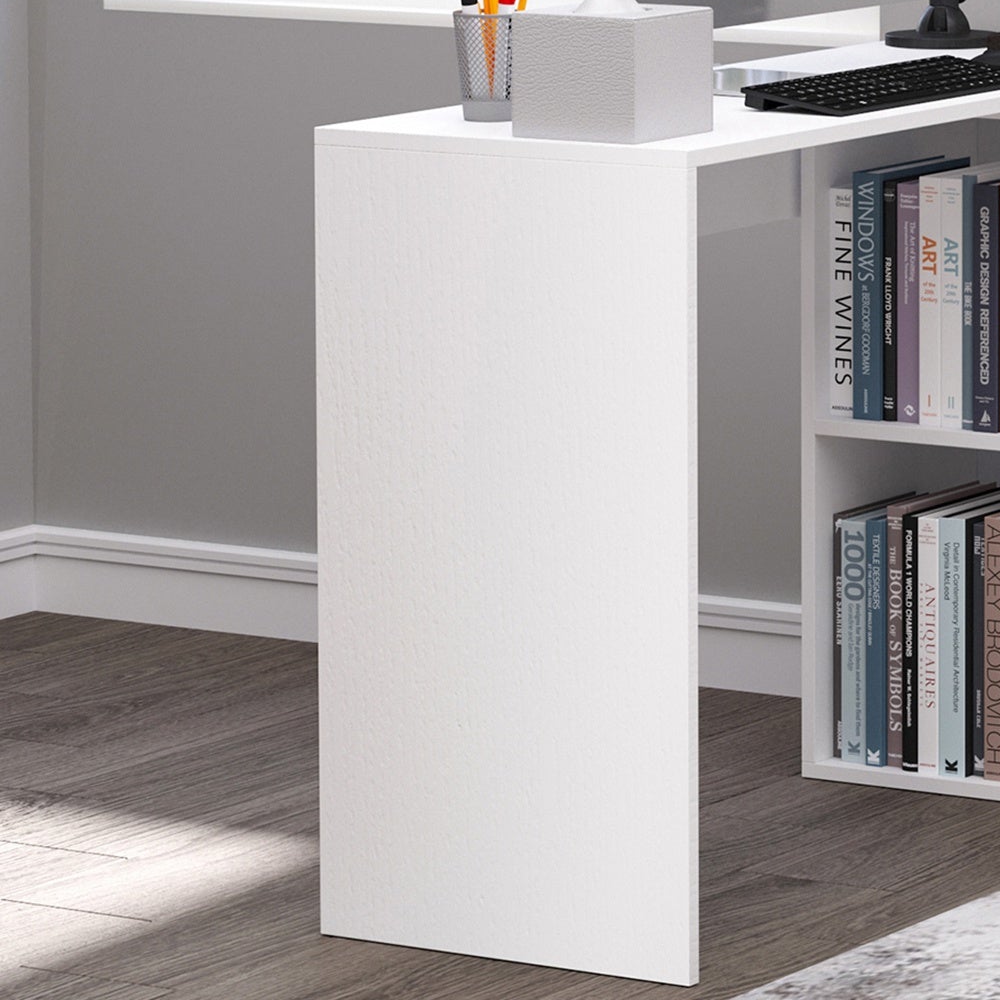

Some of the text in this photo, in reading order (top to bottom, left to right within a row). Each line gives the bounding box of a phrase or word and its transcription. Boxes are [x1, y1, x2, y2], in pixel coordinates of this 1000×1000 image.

[835, 221, 852, 281] FINE
[857, 181, 874, 281] WINDOWS
[922, 236, 936, 275] ART
[944, 237, 958, 276] ART
[980, 206, 990, 258] GRAPHIC
[964, 282, 972, 293] THE
[980, 262, 990, 305] DESIGN
[862, 292, 870, 333] BERGDORF
[835, 296, 852, 385] WINES
[862, 334, 870, 375] GOODMAN
[980, 309, 990, 385] REFERENCED
[844, 530, 864, 601] 1000
[889, 569, 902, 622] BOOK
[952, 574, 960, 624] Contemporary
[922, 583, 935, 709] ANTIQUAIRES
[889, 640, 902, 732] SYMBOLS
